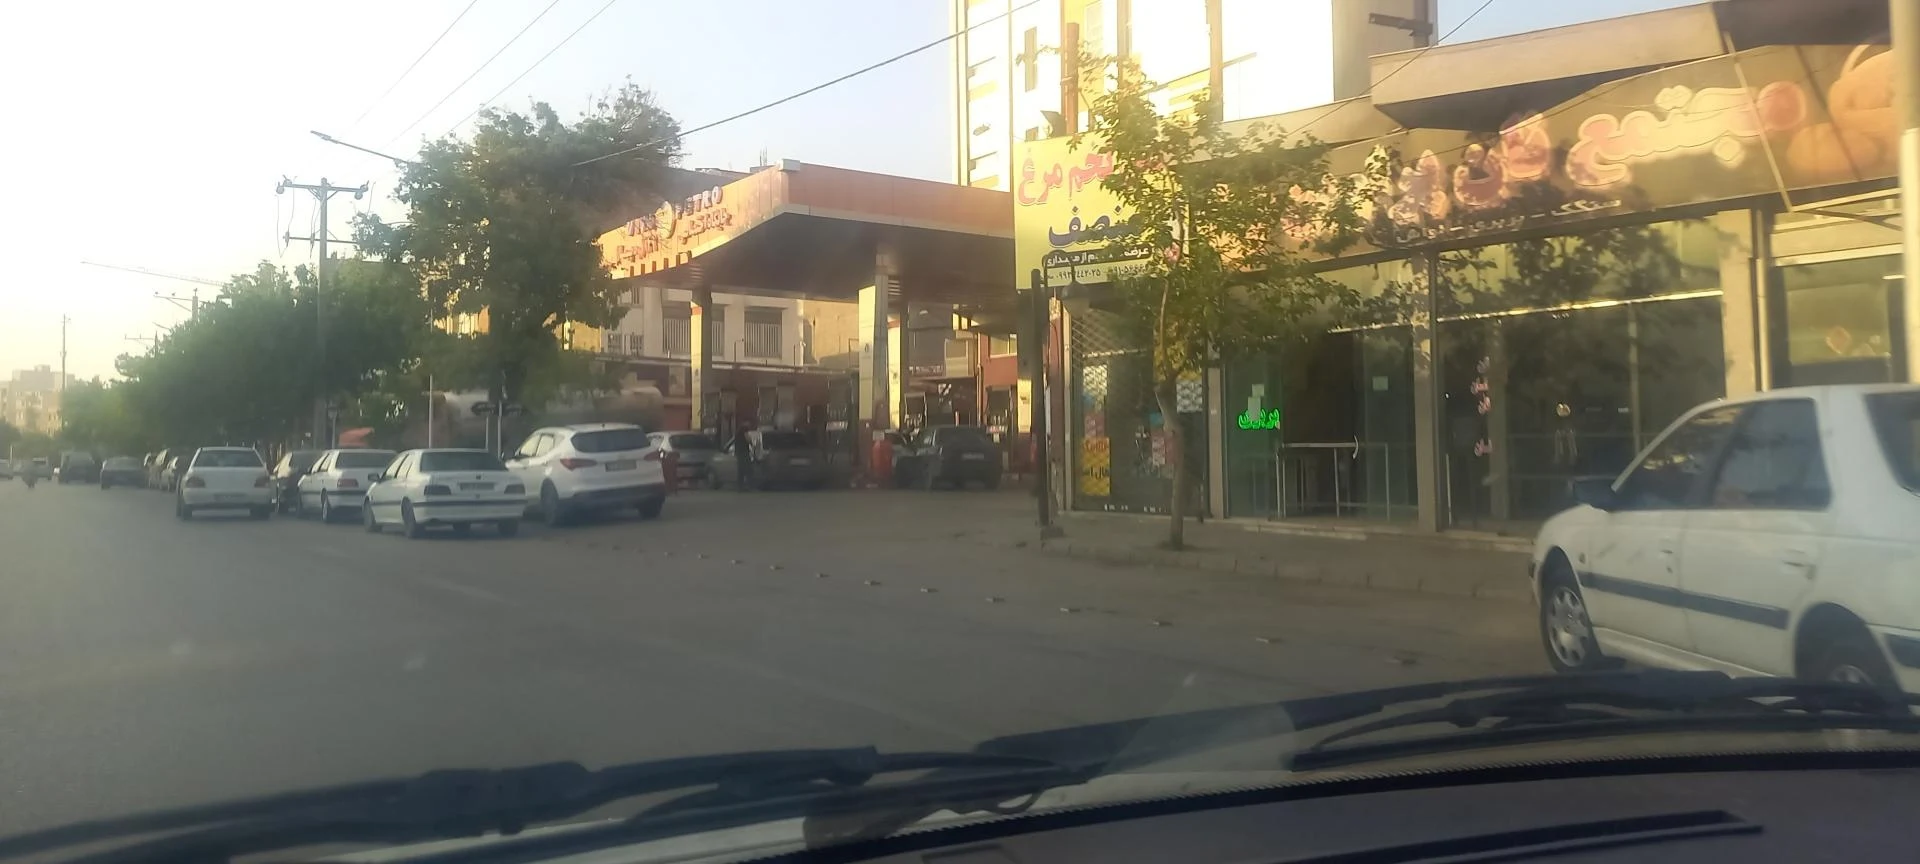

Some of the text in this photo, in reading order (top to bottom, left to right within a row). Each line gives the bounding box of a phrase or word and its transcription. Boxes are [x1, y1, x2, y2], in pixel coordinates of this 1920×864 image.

[1566, 82, 1806, 188] مجتمع
[1018, 149, 1063, 206] مرغ
[675, 185, 723, 221] PETRO
[1124, 246, 1150, 259] عرضه
